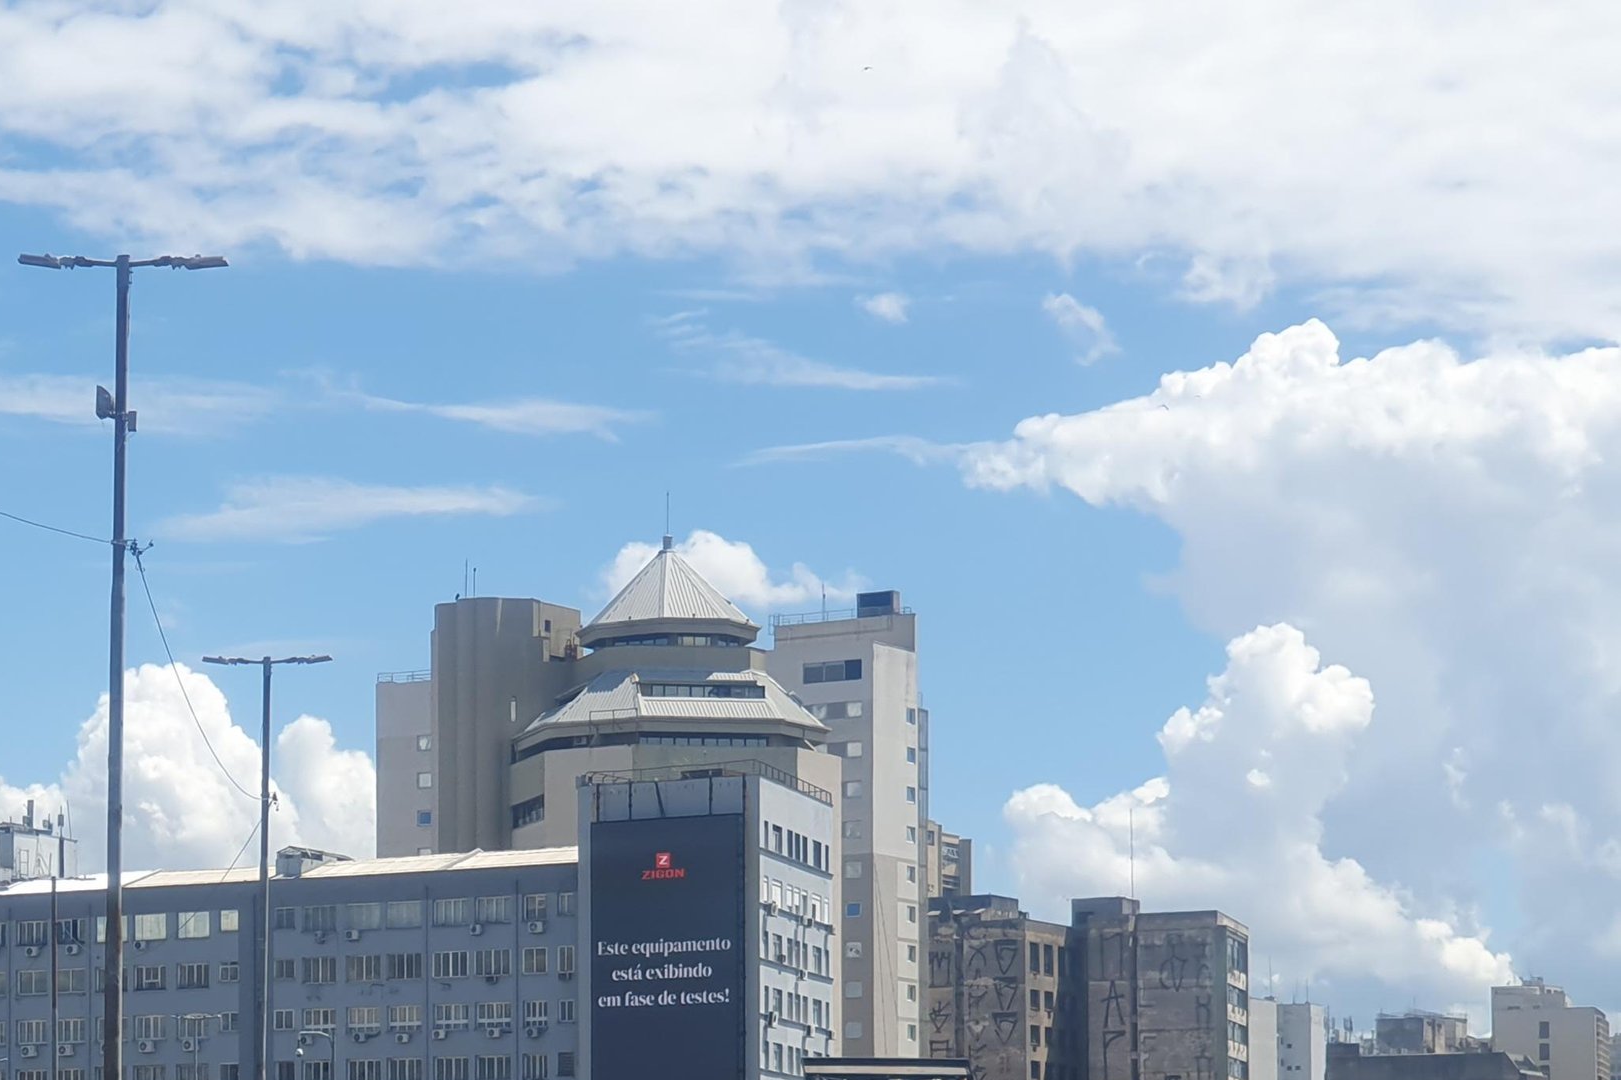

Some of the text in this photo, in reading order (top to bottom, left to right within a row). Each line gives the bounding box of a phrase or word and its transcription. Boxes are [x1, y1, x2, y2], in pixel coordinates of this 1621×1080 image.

[659, 856, 668, 865] Z
[642, 869, 685, 880] ZIGON
[597, 938, 731, 957] Este equipamento
[611, 963, 712, 981] está exibindo
[598, 988, 730, 1007] em fase de testes!
